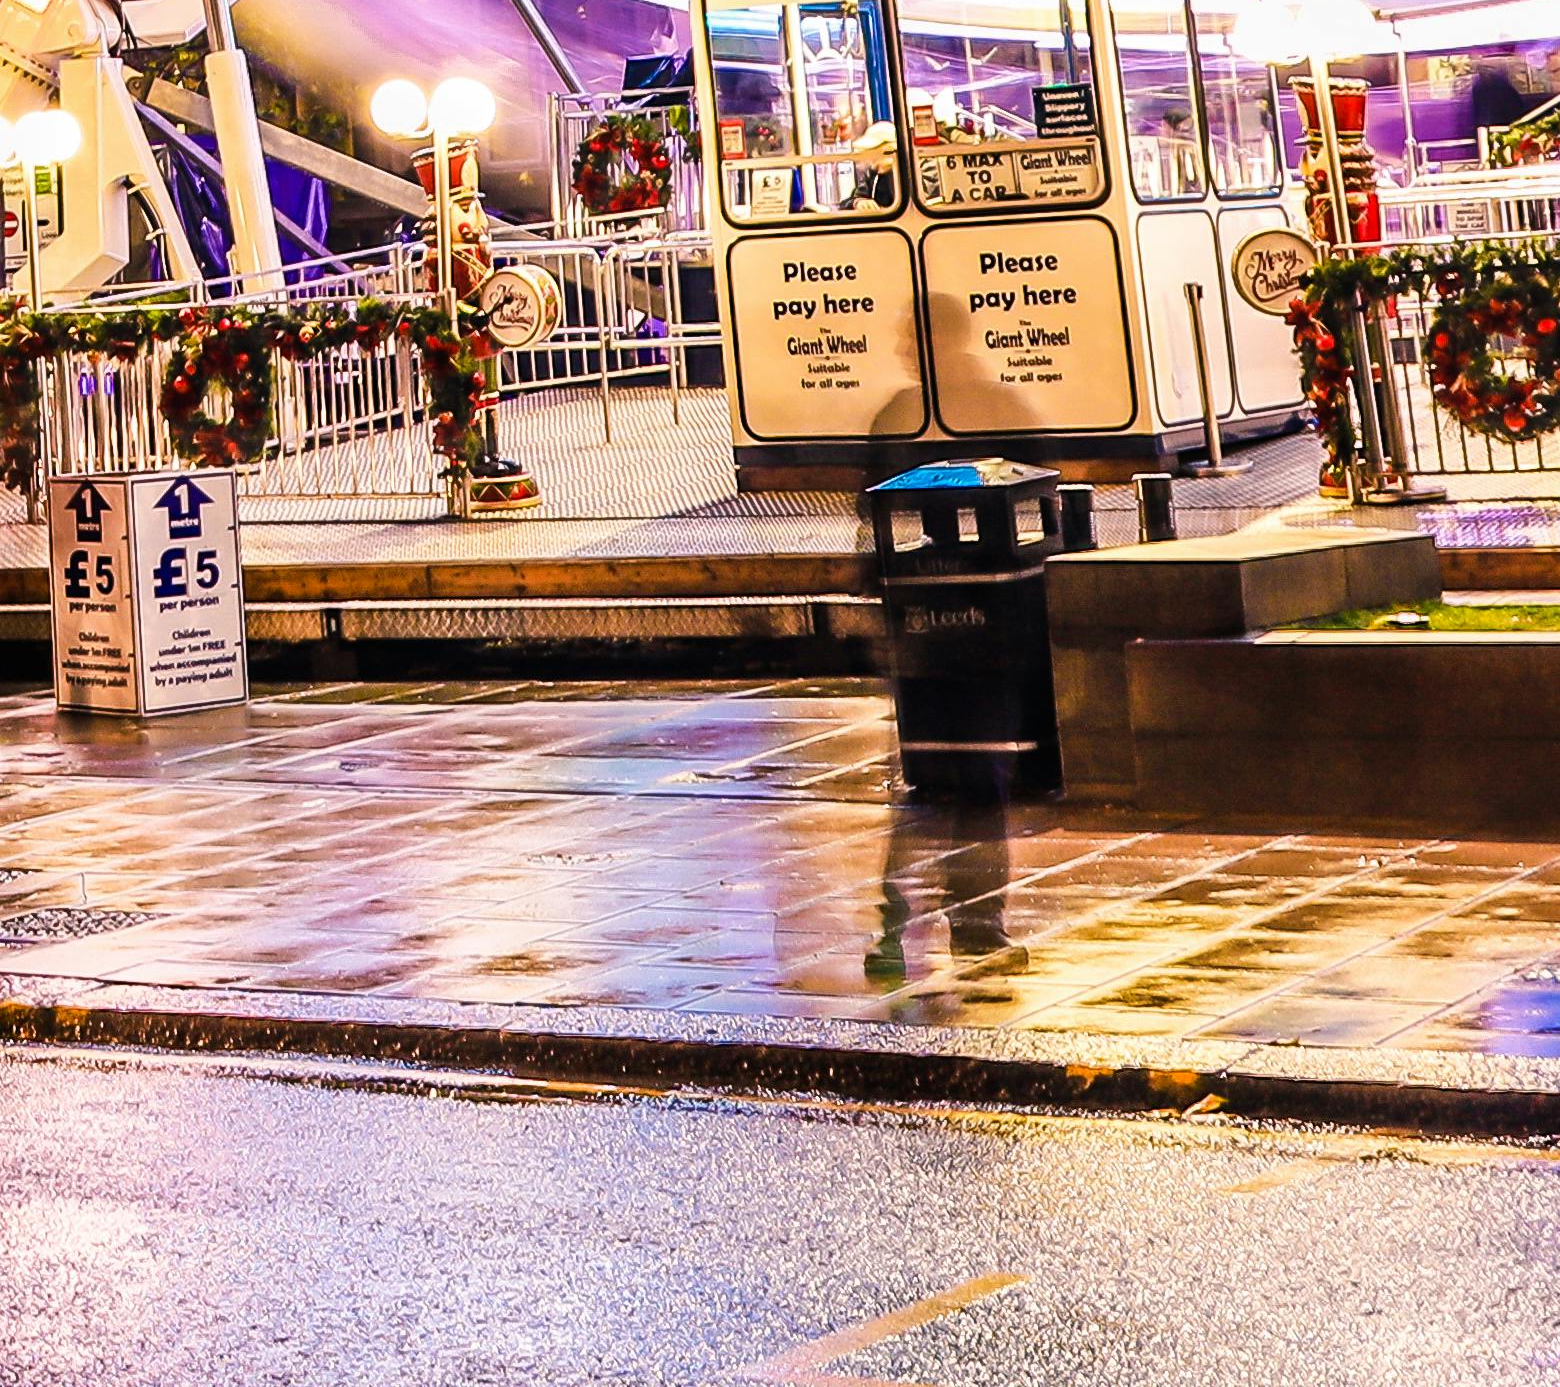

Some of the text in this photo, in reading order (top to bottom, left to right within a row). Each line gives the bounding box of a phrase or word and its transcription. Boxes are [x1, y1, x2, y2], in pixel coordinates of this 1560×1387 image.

[946, 153, 1004, 170] 6 MAX
[1021, 148, 1091, 170] Giant Wheel
[966, 170, 992, 185] TO
[951, 188, 965, 203] A
[979, 252, 1058, 274] Please
[783, 262, 857, 283] Please
[773, 293, 874, 320] pay here
[969, 284, 1077, 313] pay here
[787, 334, 867, 355] Giant Wheel
[985, 326, 1070, 349] Giant Wheel
[807, 362, 850, 374] Suitable
[1007, 355, 1053, 367] Suitable
[801, 378, 860, 388] for all ages
[1000, 372, 1062, 383] for all ages
[81, 488, 92, 518] 1
[175, 484, 189, 514] 1
[171, 518, 199, 528] metre
[64, 549, 115, 599] £5
[153, 548, 220, 599] £5
[69, 602, 117, 613] per person
[160, 597, 219, 613] per person
[79, 632, 110, 642] Children
[172, 628, 211, 640] Children
[68, 646, 90, 655] under
[103, 648, 122, 658] FREE
[159, 645, 185, 656] under
[203, 640, 226, 650] FREE
[150, 652, 237, 672] when accompanied
[155, 676, 167, 687] by
[176, 672, 207, 685] paying
[209, 668, 233, 679] adult
